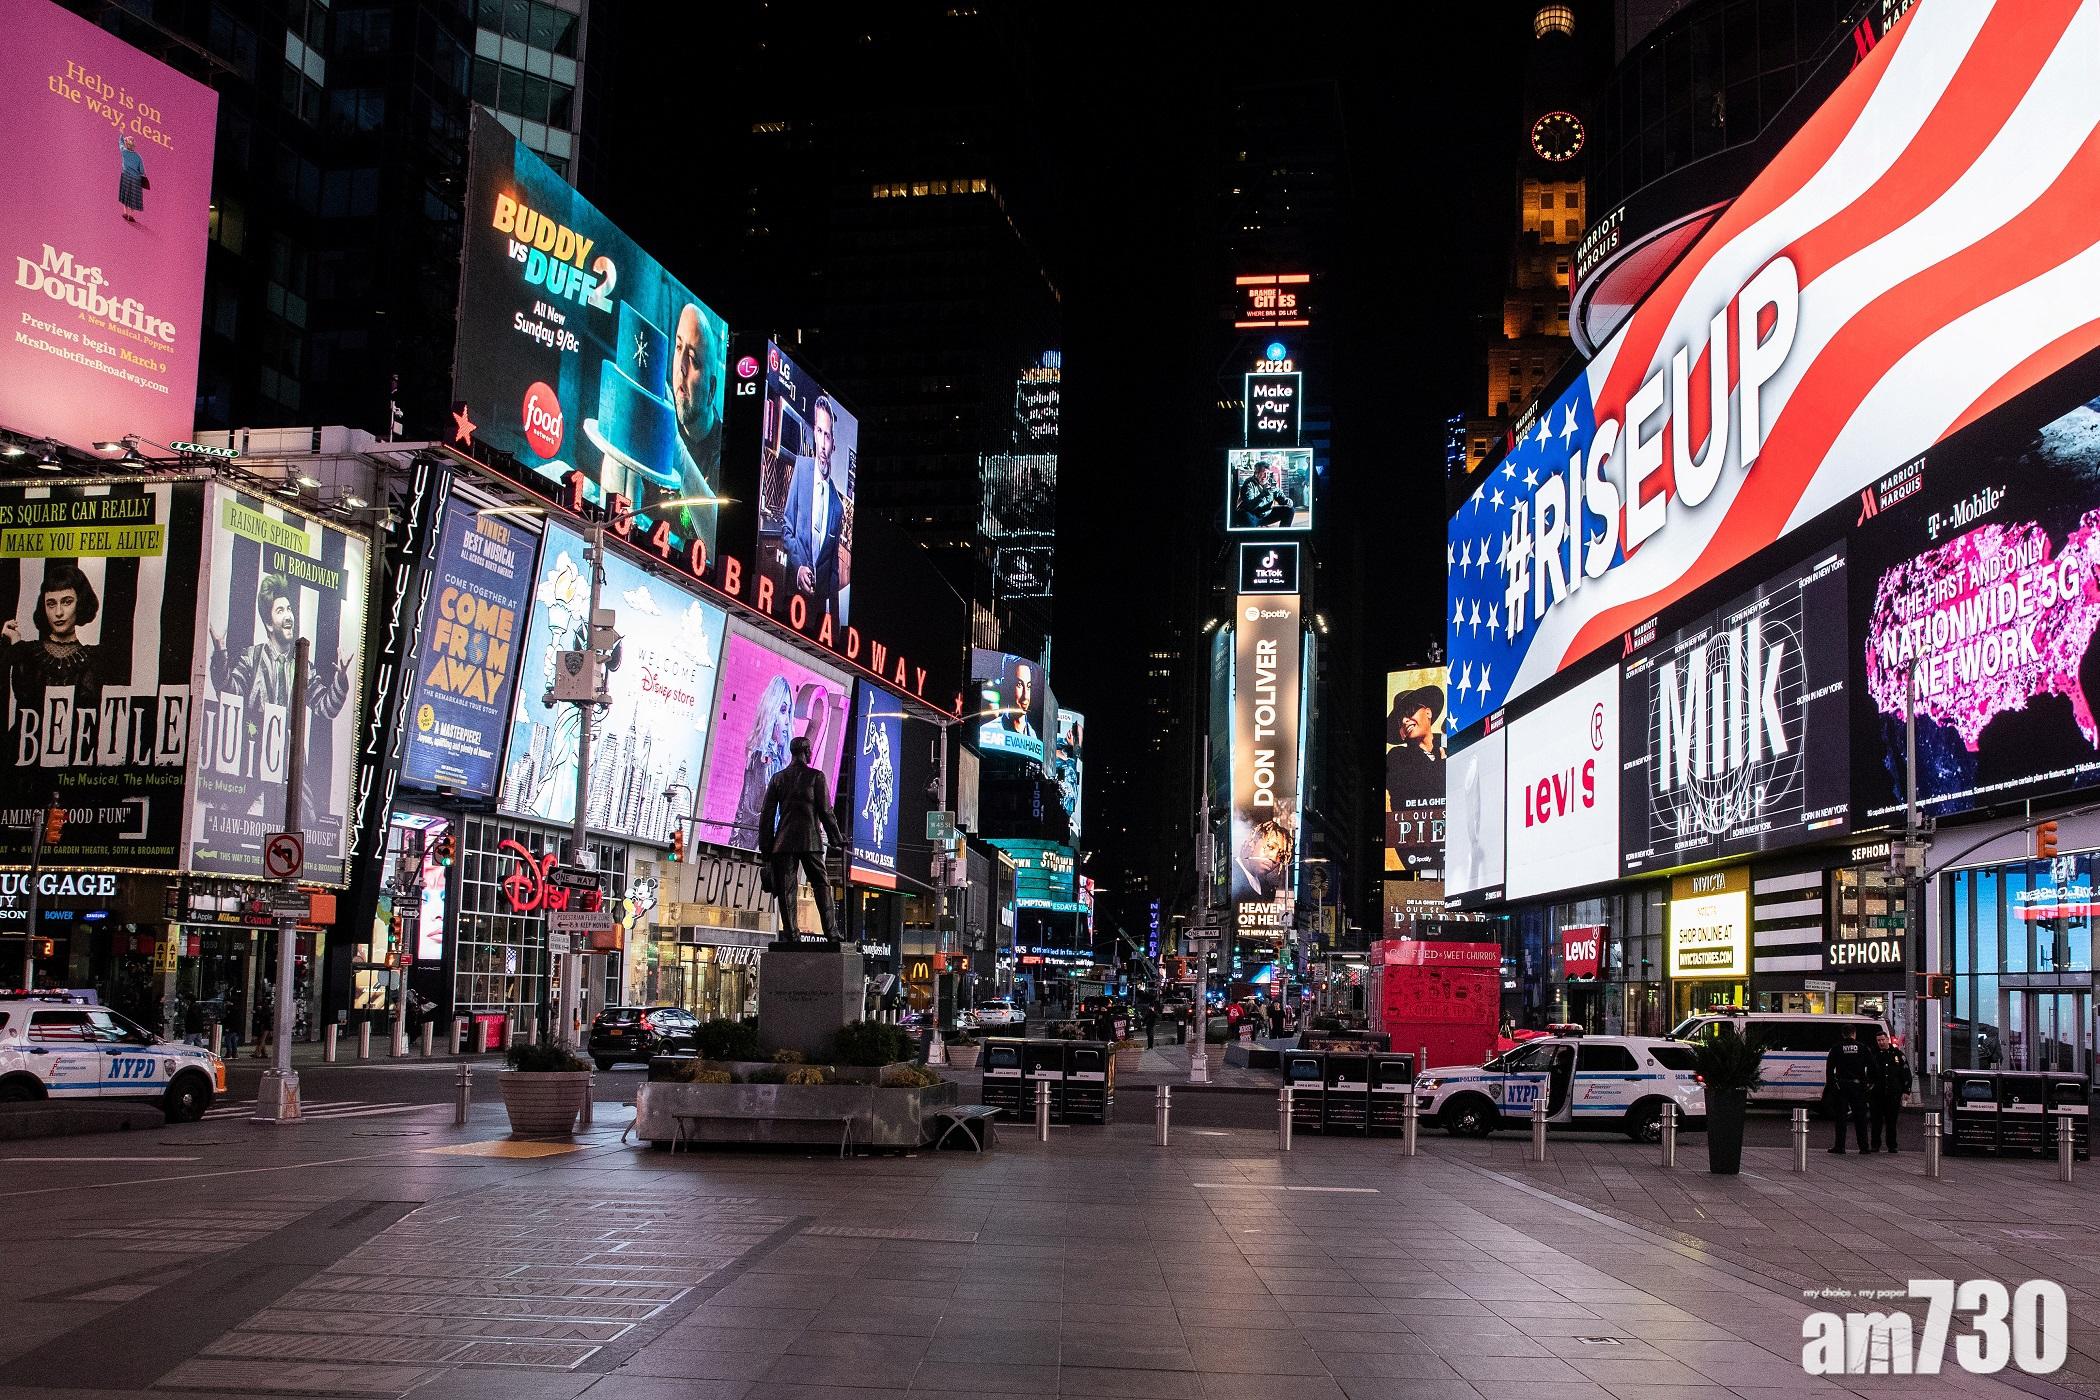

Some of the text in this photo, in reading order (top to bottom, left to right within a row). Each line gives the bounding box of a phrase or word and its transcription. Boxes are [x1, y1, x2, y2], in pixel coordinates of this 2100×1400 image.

[66, 60, 161, 124] Help is on
[48, 75, 174, 151] the way, dear.
[492, 193, 594, 269] BUDDY
[1577, 206, 1625, 263] MARRIOTT
[40, 243, 109, 287] Mrs.
[1577, 232, 1618, 281] MARQUIS
[508, 239, 617, 314] VS DUFF 2
[15, 256, 175, 343] Doubtfire
[88, 316, 106, 327] New
[533, 300, 566, 324] All New
[22, 313, 167, 373] Previews begin March 9
[514, 312, 580, 353] Sunday 9/8c
[15, 331, 169, 393] MrsDoubtfireBroadway.com
[780, 358, 790, 381] LG
[1256, 359, 1293, 373] 2020
[737, 382, 756, 395] LG
[1253, 384, 1293, 398] Make
[524, 395, 563, 438] food
[1256, 401, 1290, 417] your
[1258, 415, 1288, 432] day.
[533, 428, 555, 445] network
[177, 442, 233, 457] LAMAR
[1505, 256, 1799, 639] #RISEUP
[1880, 457, 1926, 493] MARRIOTT
[1880, 477, 1921, 508] MARQUIS
[17, 498, 151, 526] SQUARE CAN REALLY
[6, 530, 160, 552] MAKE YOU FEEL ALIVE!
[230, 508, 303, 553] RAISING SPIRITS
[476, 515, 510, 546] WINNER!
[463, 530, 515, 568] BEST MUSICAL
[273, 552, 339, 590] ON BROADWAY!
[1255, 569, 1283, 577] TikTok
[1899, 535, 2047, 618] THE FIRST AND ONLY
[445, 573, 517, 608] COME TOGETHER AT
[567, 470, 927, 695] 1540 BROADWAY
[440, 587, 514, 642] COME
[1260, 609, 1290, 620] Spotify
[1883, 555, 2080, 671] NATIONWIDE 5G
[1634, 617, 1658, 637] MARRIOTT
[1634, 631, 1655, 649] MARQUIS
[1914, 619, 2039, 701] NETWORK
[426, 655, 504, 704] AWAY
[1254, 639, 1278, 741] TOLIVER
[1829, 681, 1844, 693] YORK
[423, 689, 498, 715] THE REMARKABLE TRUE STORY
[673, 689, 695, 707] store
[1659, 618, 1789, 792] Milk
[14, 686, 188, 767] BEETLE
[441, 722, 481, 745] MASTERPIECE!
[1005, 734, 1026, 749] EVAN
[58, 773, 76, 786] The
[124, 774, 143, 786] The
[199, 777, 247, 796] The Musical
[1253, 750, 1275, 808] DON
[1406, 799, 1428, 807] DE LA
[1677, 786, 1765, 837] MAKEUP
[1833, 804, 1848, 814] YORK
[1395, 812, 1433, 821] EL QUE
[54, 846, 175, 856] GARDEN THEATRE, 50TH BROADWAY
[220, 852, 243, 863] THIS WAY
[865, 851, 895, 868] POLO ASSN.
[1852, 843, 1890, 860] SEPHORA
[556, 873, 593, 885] ONE WAY
[1693, 873, 1726, 893] INVICTA
[45, 911, 74, 920] BOWER
[197, 913, 213, 922] Apple
[217, 913, 241, 923] Nikon
[1240, 903, 1285, 913] HEAVEN
[244, 914, 272, 925] Canon
[1238, 915, 1256, 925] OR
[1679, 924, 1733, 943] SHOP ONLINE AT
[168, 944, 176, 968] ATM
[714, 946, 751, 965] FOREVER
[862, 944, 891, 958] sunglass hut
[1444, 951, 1496, 960] SWEET CHURROS
[1679, 951, 1732, 966] INVICTASTORES.COM
[1830, 941, 1900, 964] SEPHORA
[108, 1058, 156, 1078] NYPD
[1508, 1086, 1538, 1102] NYPD
